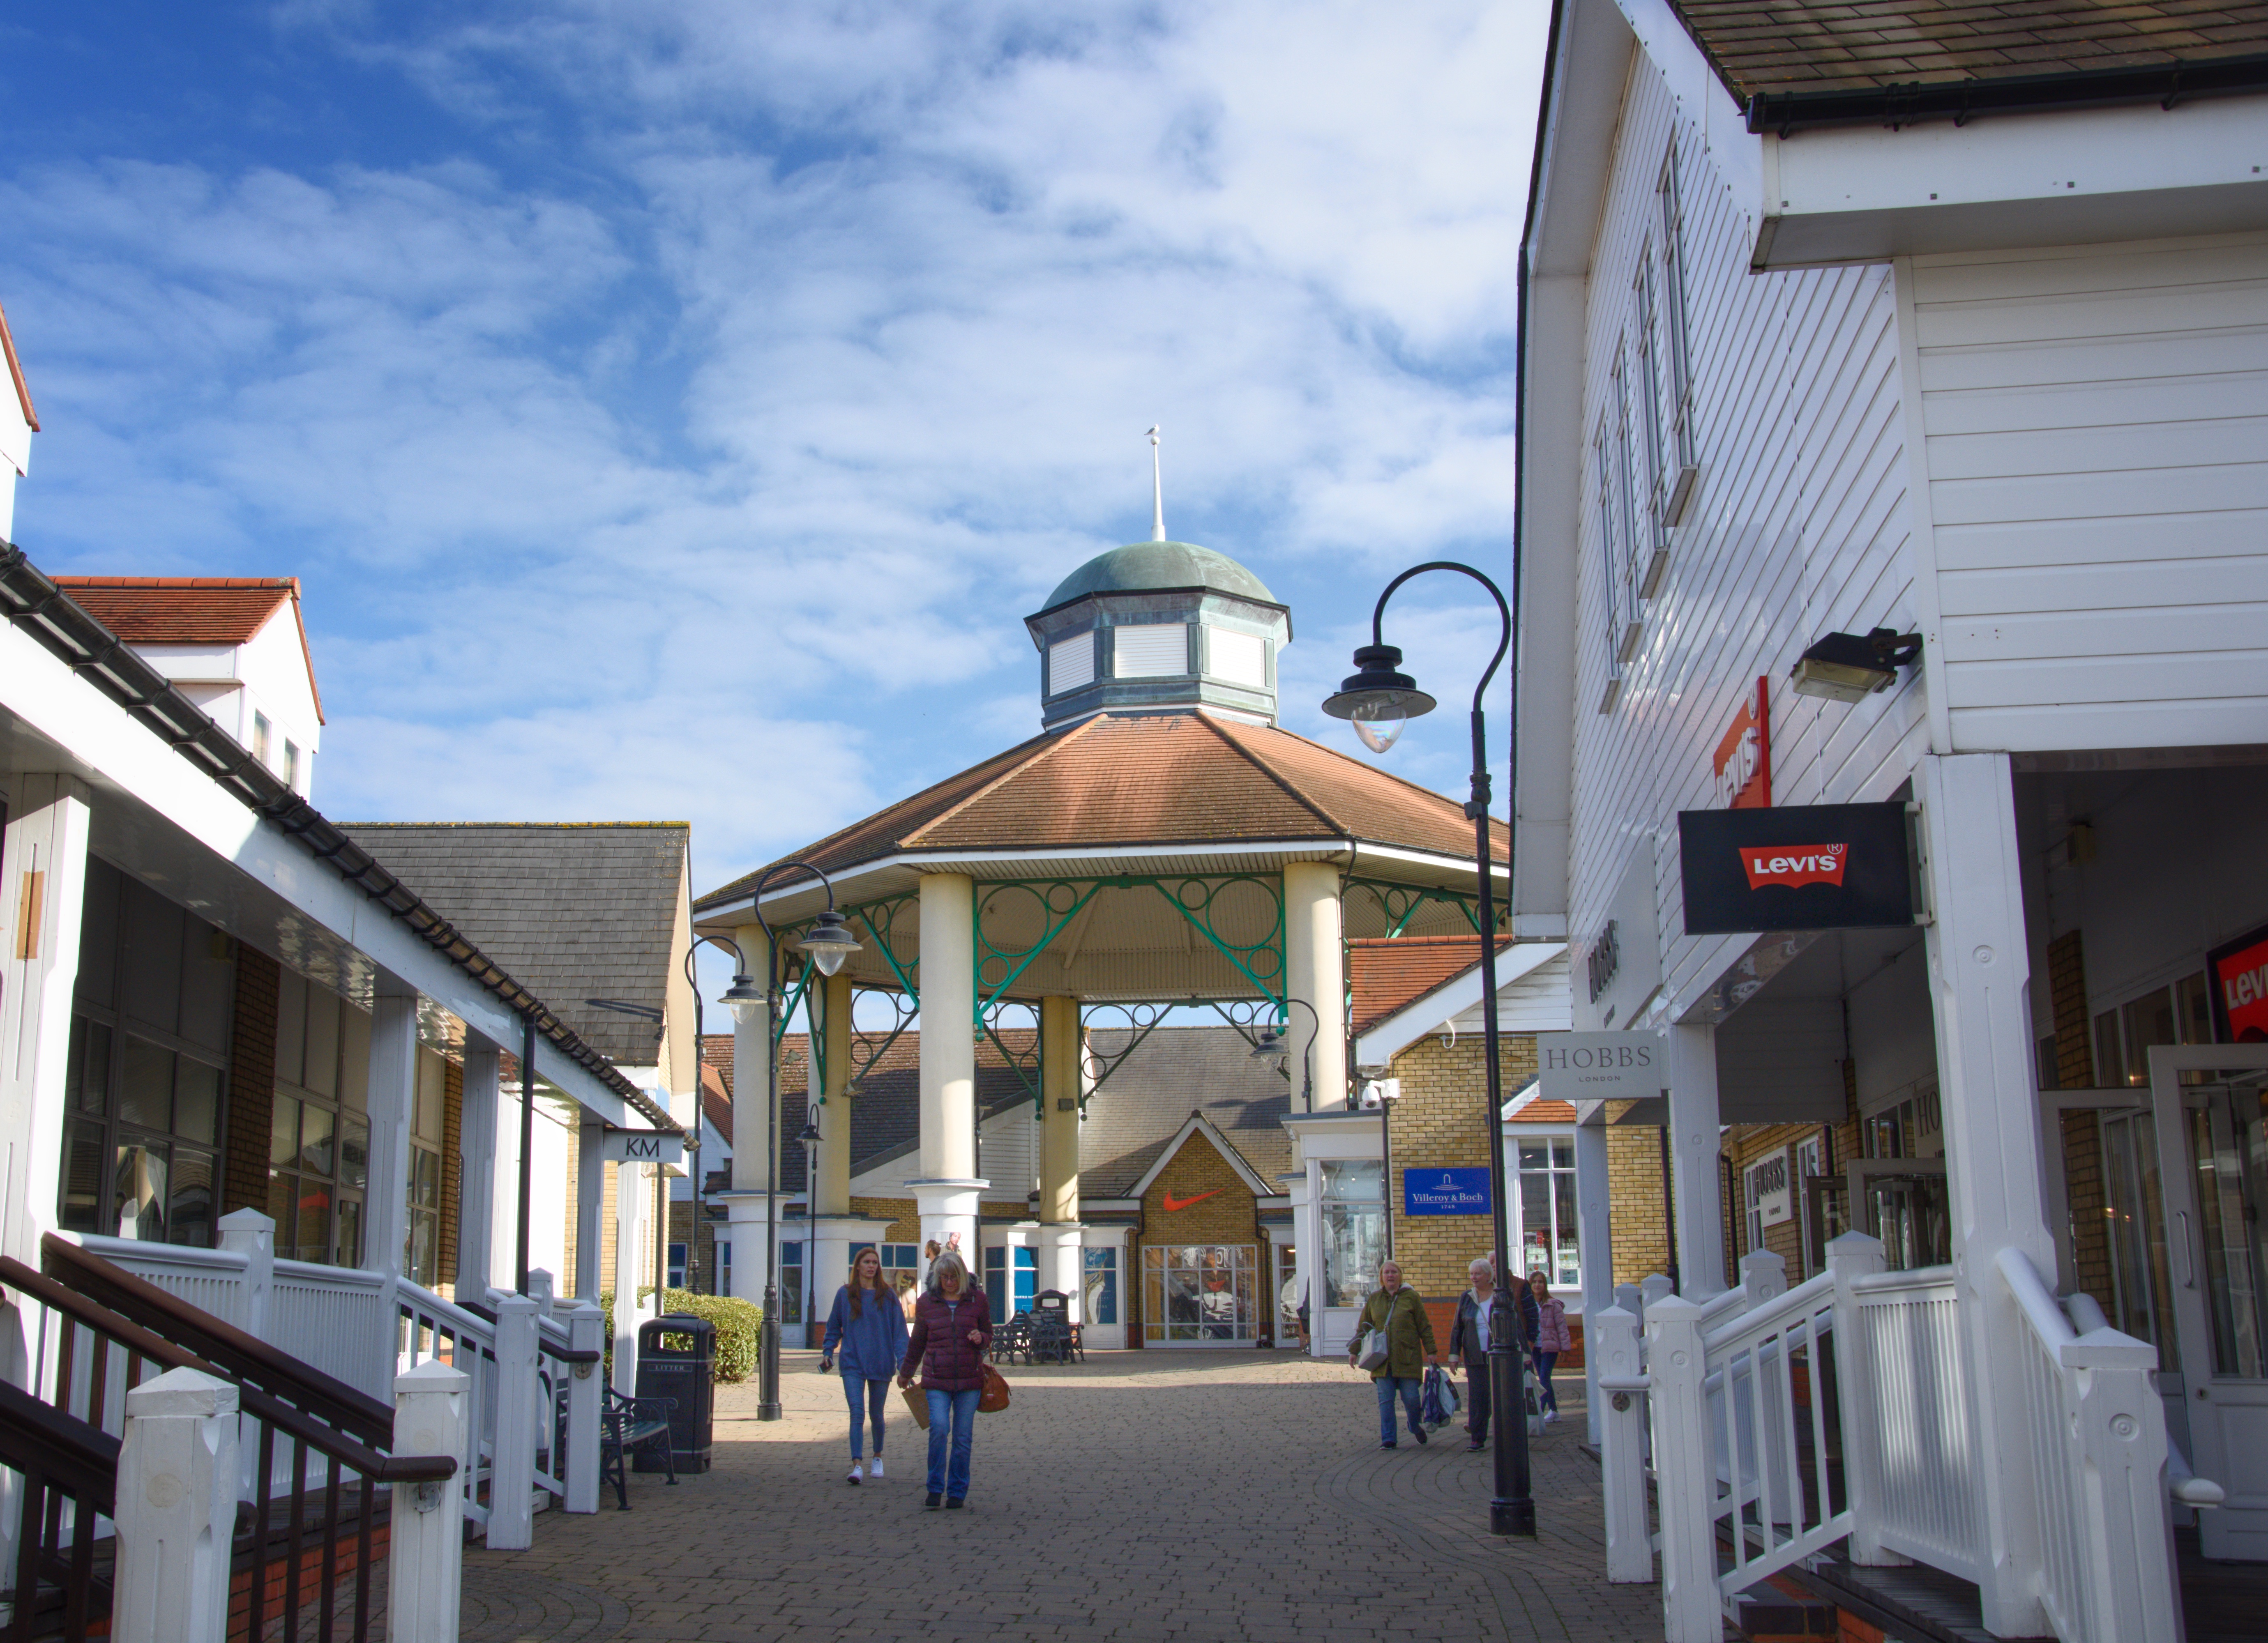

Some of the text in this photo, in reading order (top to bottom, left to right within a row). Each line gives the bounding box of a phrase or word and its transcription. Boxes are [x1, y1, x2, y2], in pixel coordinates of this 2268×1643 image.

[1588, 919, 1617, 1004] HOBBS
[1546, 1046, 1651, 1069] HOBBS
[626, 1137, 659, 1157] KM
[1755, 1155, 1785, 1197] HOBBS
[1412, 1193, 1449, 1203] Villeroy
[1459, 1192, 1483, 1201] Boch
